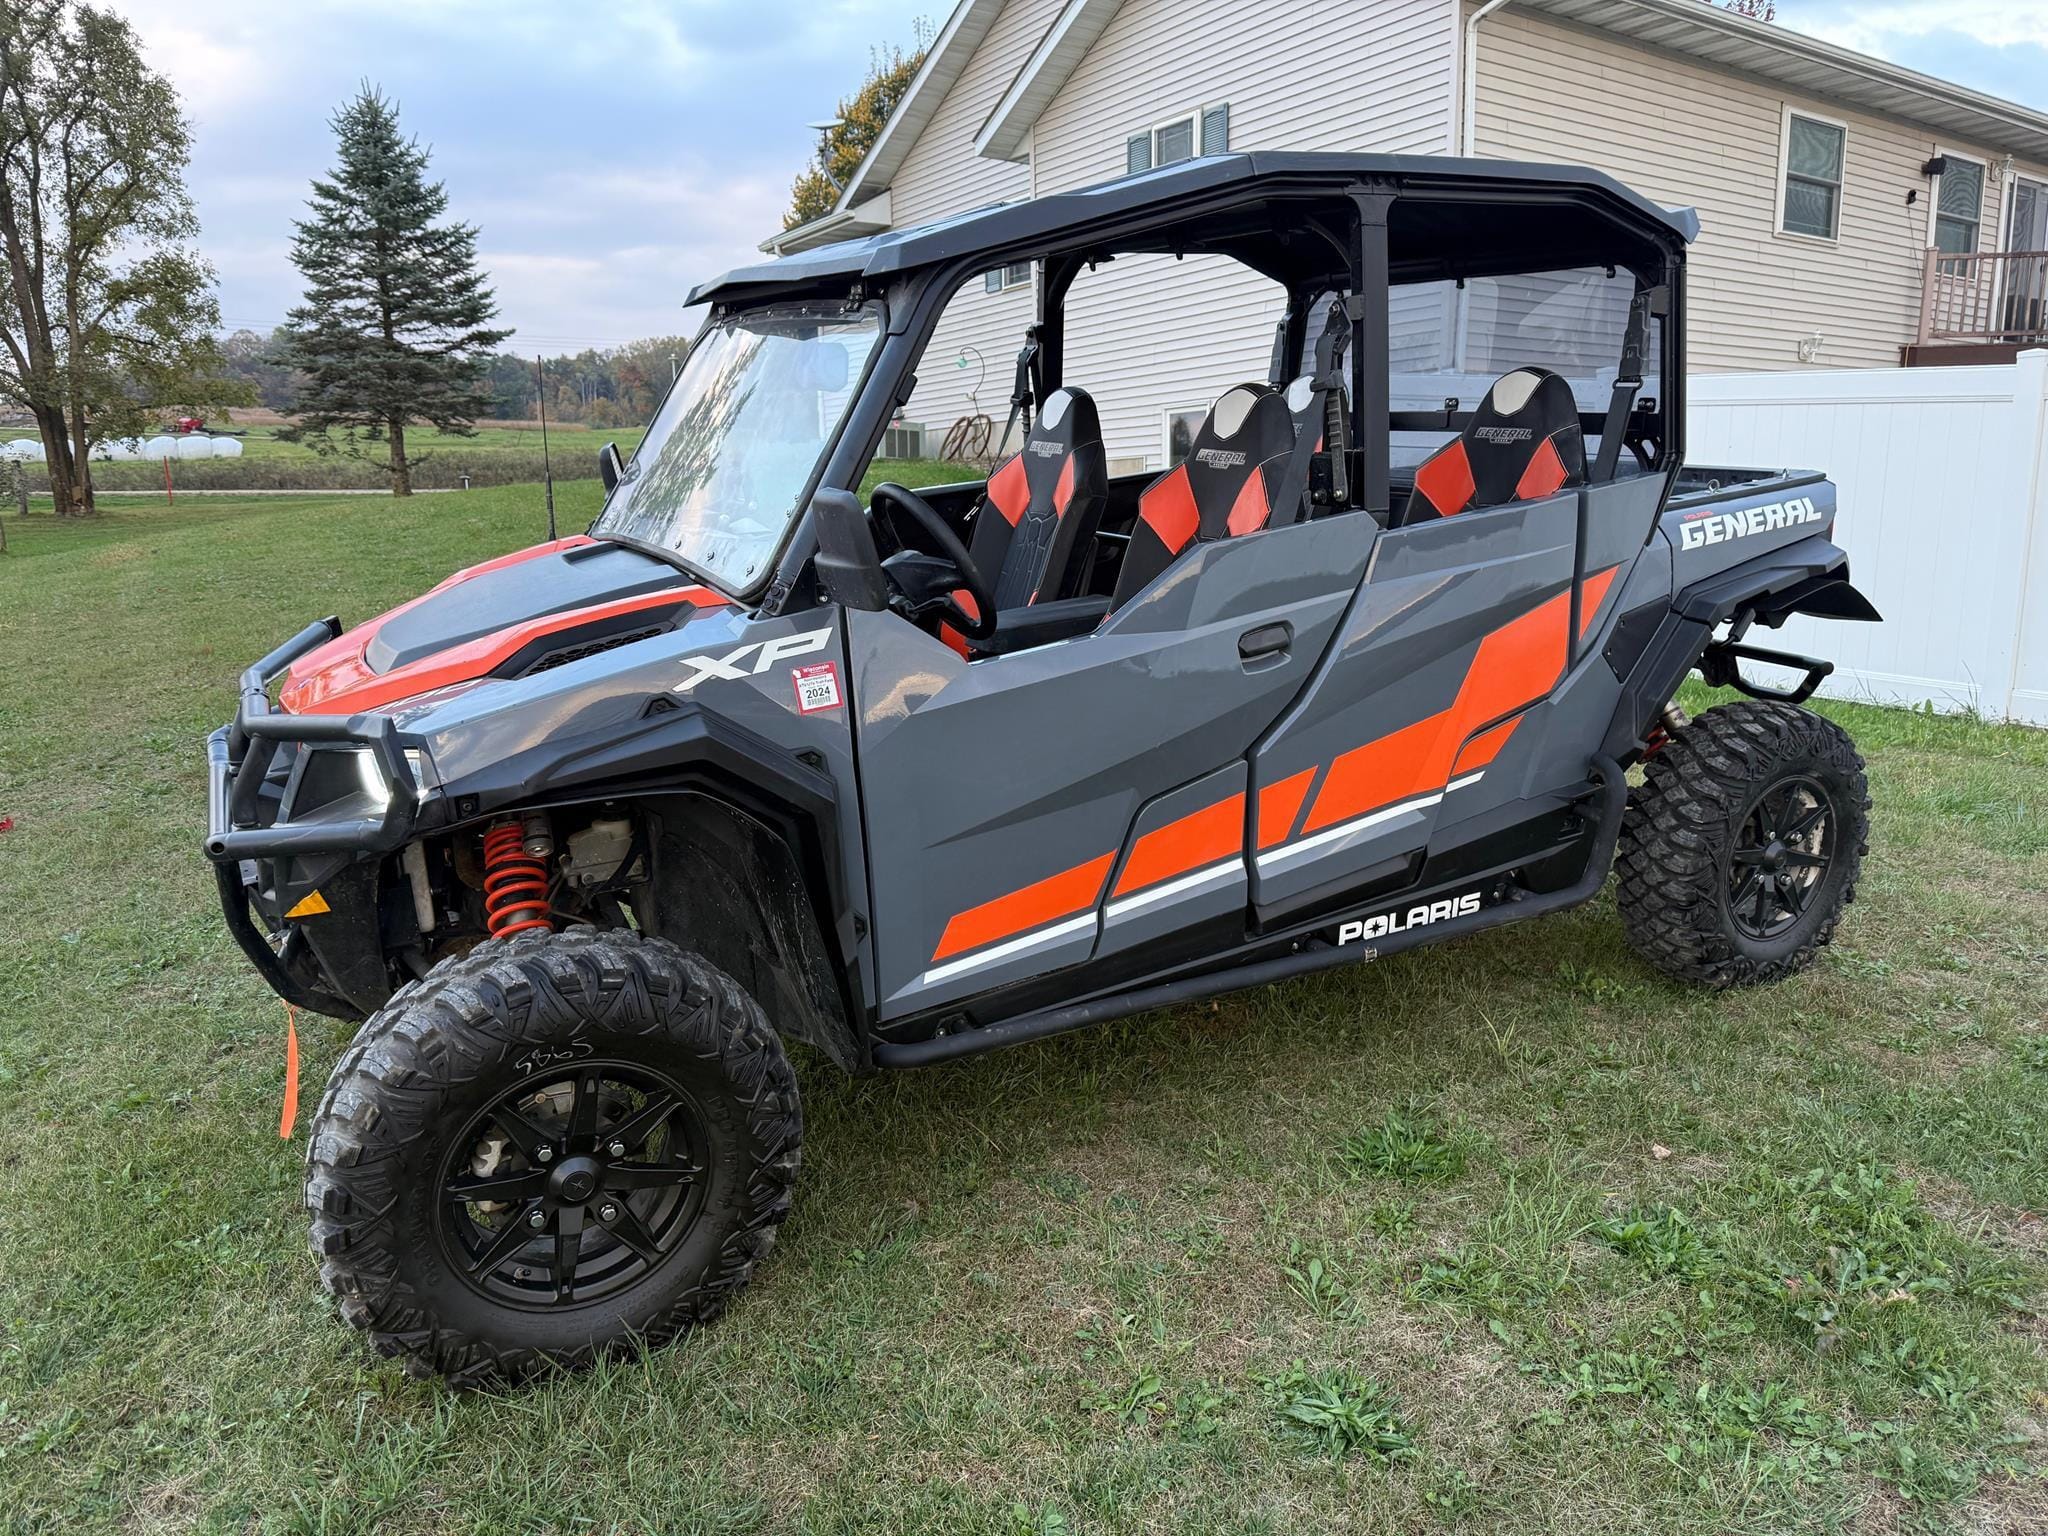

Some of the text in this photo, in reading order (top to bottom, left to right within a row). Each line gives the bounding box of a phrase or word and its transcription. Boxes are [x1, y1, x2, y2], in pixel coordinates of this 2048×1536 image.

[1474, 426, 1533, 440] GENERAL
[1028, 440, 1064, 455] GENERAL
[1195, 448, 1246, 465] GENERAL
[1679, 497, 1822, 551] GENERAL
[671, 626, 834, 693] XP
[806, 686, 830, 699] 2024
[1338, 891, 1481, 946] POLARIS
